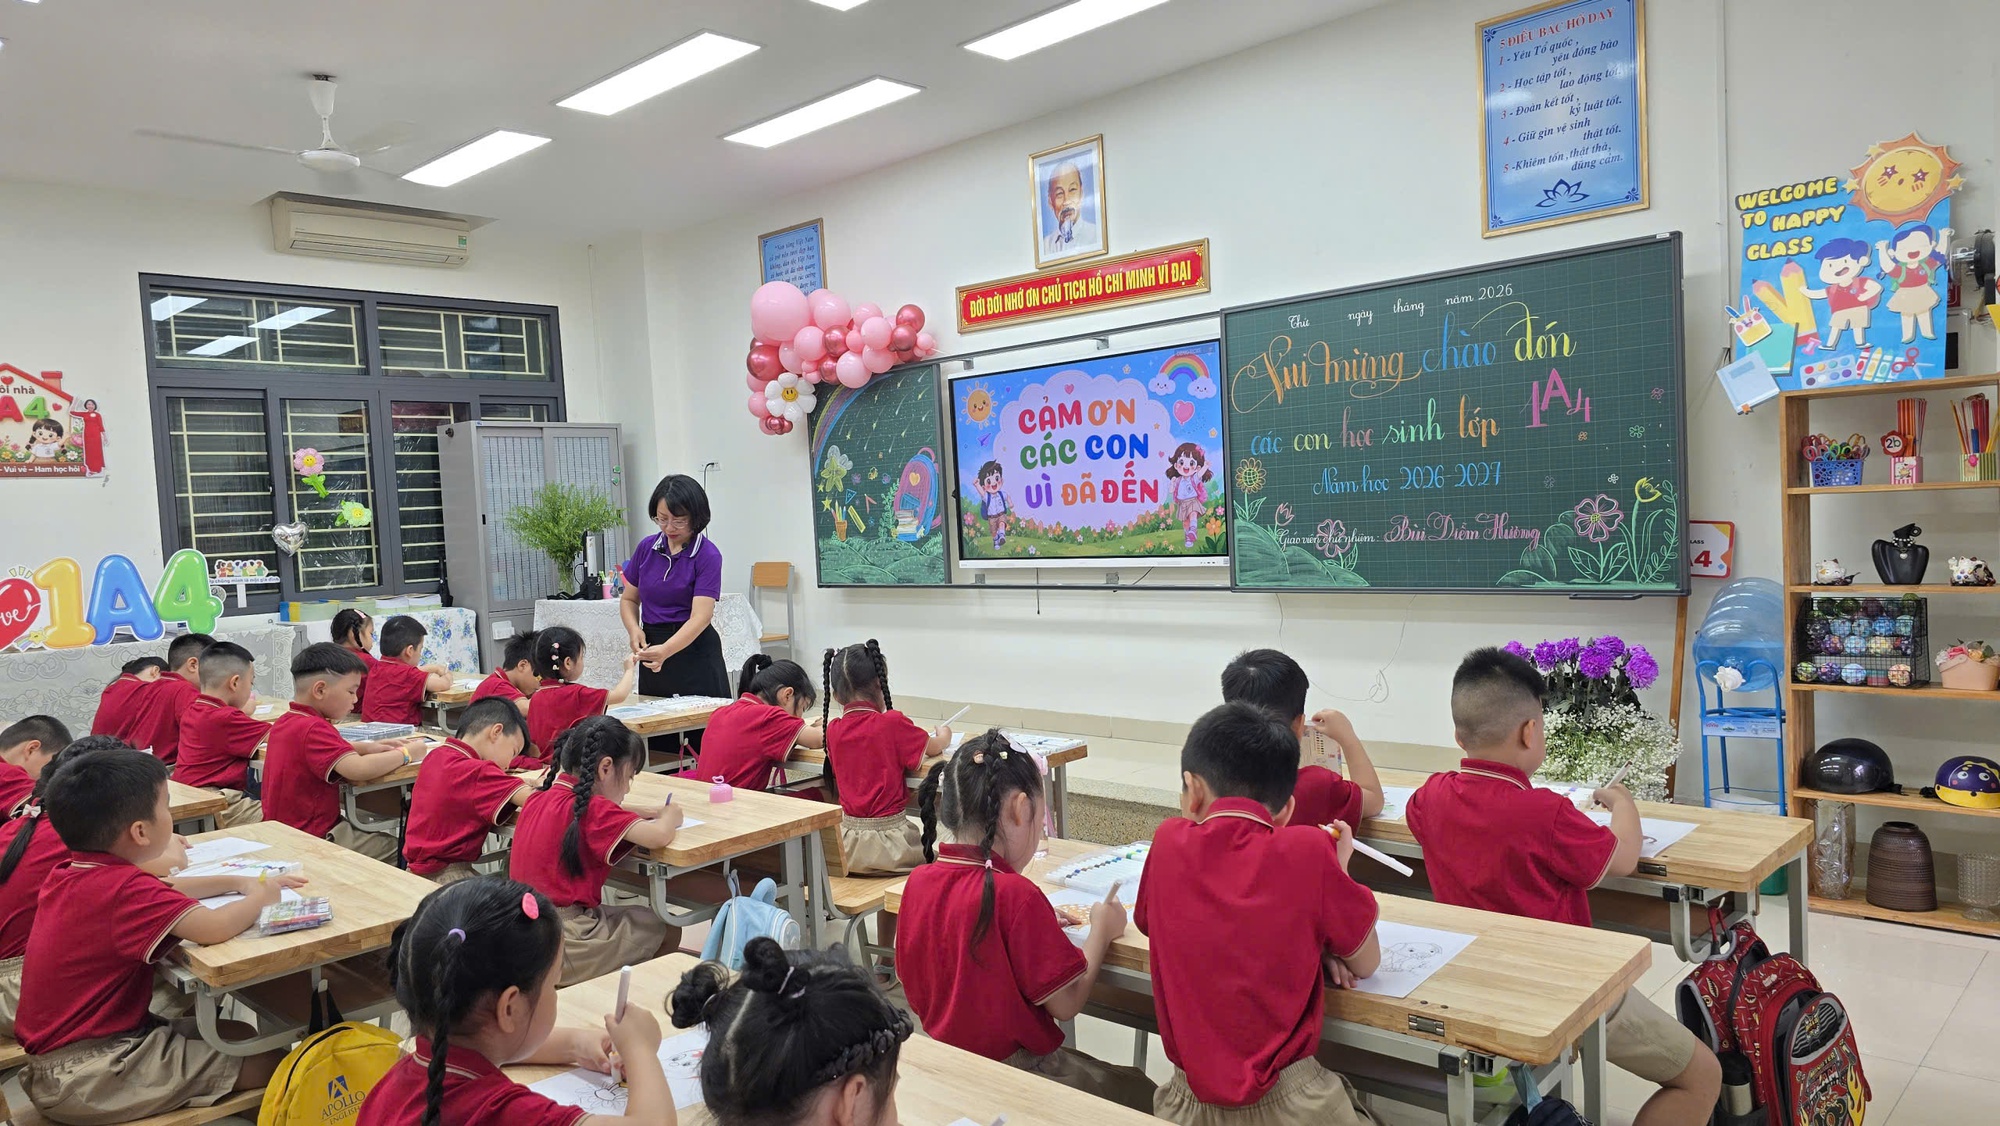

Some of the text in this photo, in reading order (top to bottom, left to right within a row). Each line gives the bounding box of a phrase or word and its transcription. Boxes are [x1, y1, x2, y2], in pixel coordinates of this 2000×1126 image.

[1499, 39, 1506, 50] 5
[1508, 27, 1534, 47] ĐIỀU
[1539, 21, 1564, 38] BÁC
[1567, 12, 1586, 30] HỒ
[1513, 50, 1531, 62] Yêu
[1534, 41, 1549, 56] Tổ
[1552, 52, 1570, 66] yêu
[1499, 83, 1505, 92] 2
[1514, 77, 1534, 89] Học
[1560, 79, 1575, 89] lao
[1577, 71, 1603, 86] động
[1501, 110, 1507, 119] 3
[1515, 102, 1541, 116] Đoàn
[1544, 97, 1559, 109] kết
[1584, 99, 1603, 112] luật
[1503, 136, 1509, 146] 4
[1518, 131, 1536, 142] Giữ
[1538, 127, 1553, 140] gìn
[1557, 122, 1567, 135] vệ
[1569, 117, 1591, 131] sinh
[1583, 128, 1603, 141] thật
[1503, 164, 1509, 173] 5
[1571, 158, 1597, 171] dũng
[1737, 176, 1838, 210] WELCOME
[1741, 204, 1846, 232] TO HAPPY
[969, 259, 1192, 318] ĐỜI ĐỜI NHỚ ƠN CHỦ TỊCH HỒ CHÍ MINH VĨ ĐẠI
[1287, 282, 1514, 330] Thứ ngày tháng năm 2026
[1231, 301, 1577, 413] Vui mừng chào đón
[13, 384, 36, 395] nhà
[1018, 395, 1136, 434] CẢM ƠN
[1250, 367, 1593, 456] các con học sinh lớp 1A4
[1020, 431, 1149, 470] CÁC CON
[1885, 436, 1902, 449] 2b
[53, 465, 67, 474] học
[1061, 472, 1097, 506] ĐÃ
[1101, 460, 1159, 503] ĐẾN
[1312, 466, 1359, 495] Năm
[1361, 464, 1390, 494] học
[1399, 464, 1445, 490] 2026
[1454, 461, 1501, 487] 2027
[1384, 514, 1426, 543] Bùi
[32, 549, 223, 650] 1A4
[322, 1090, 366, 1120] APOLLO
